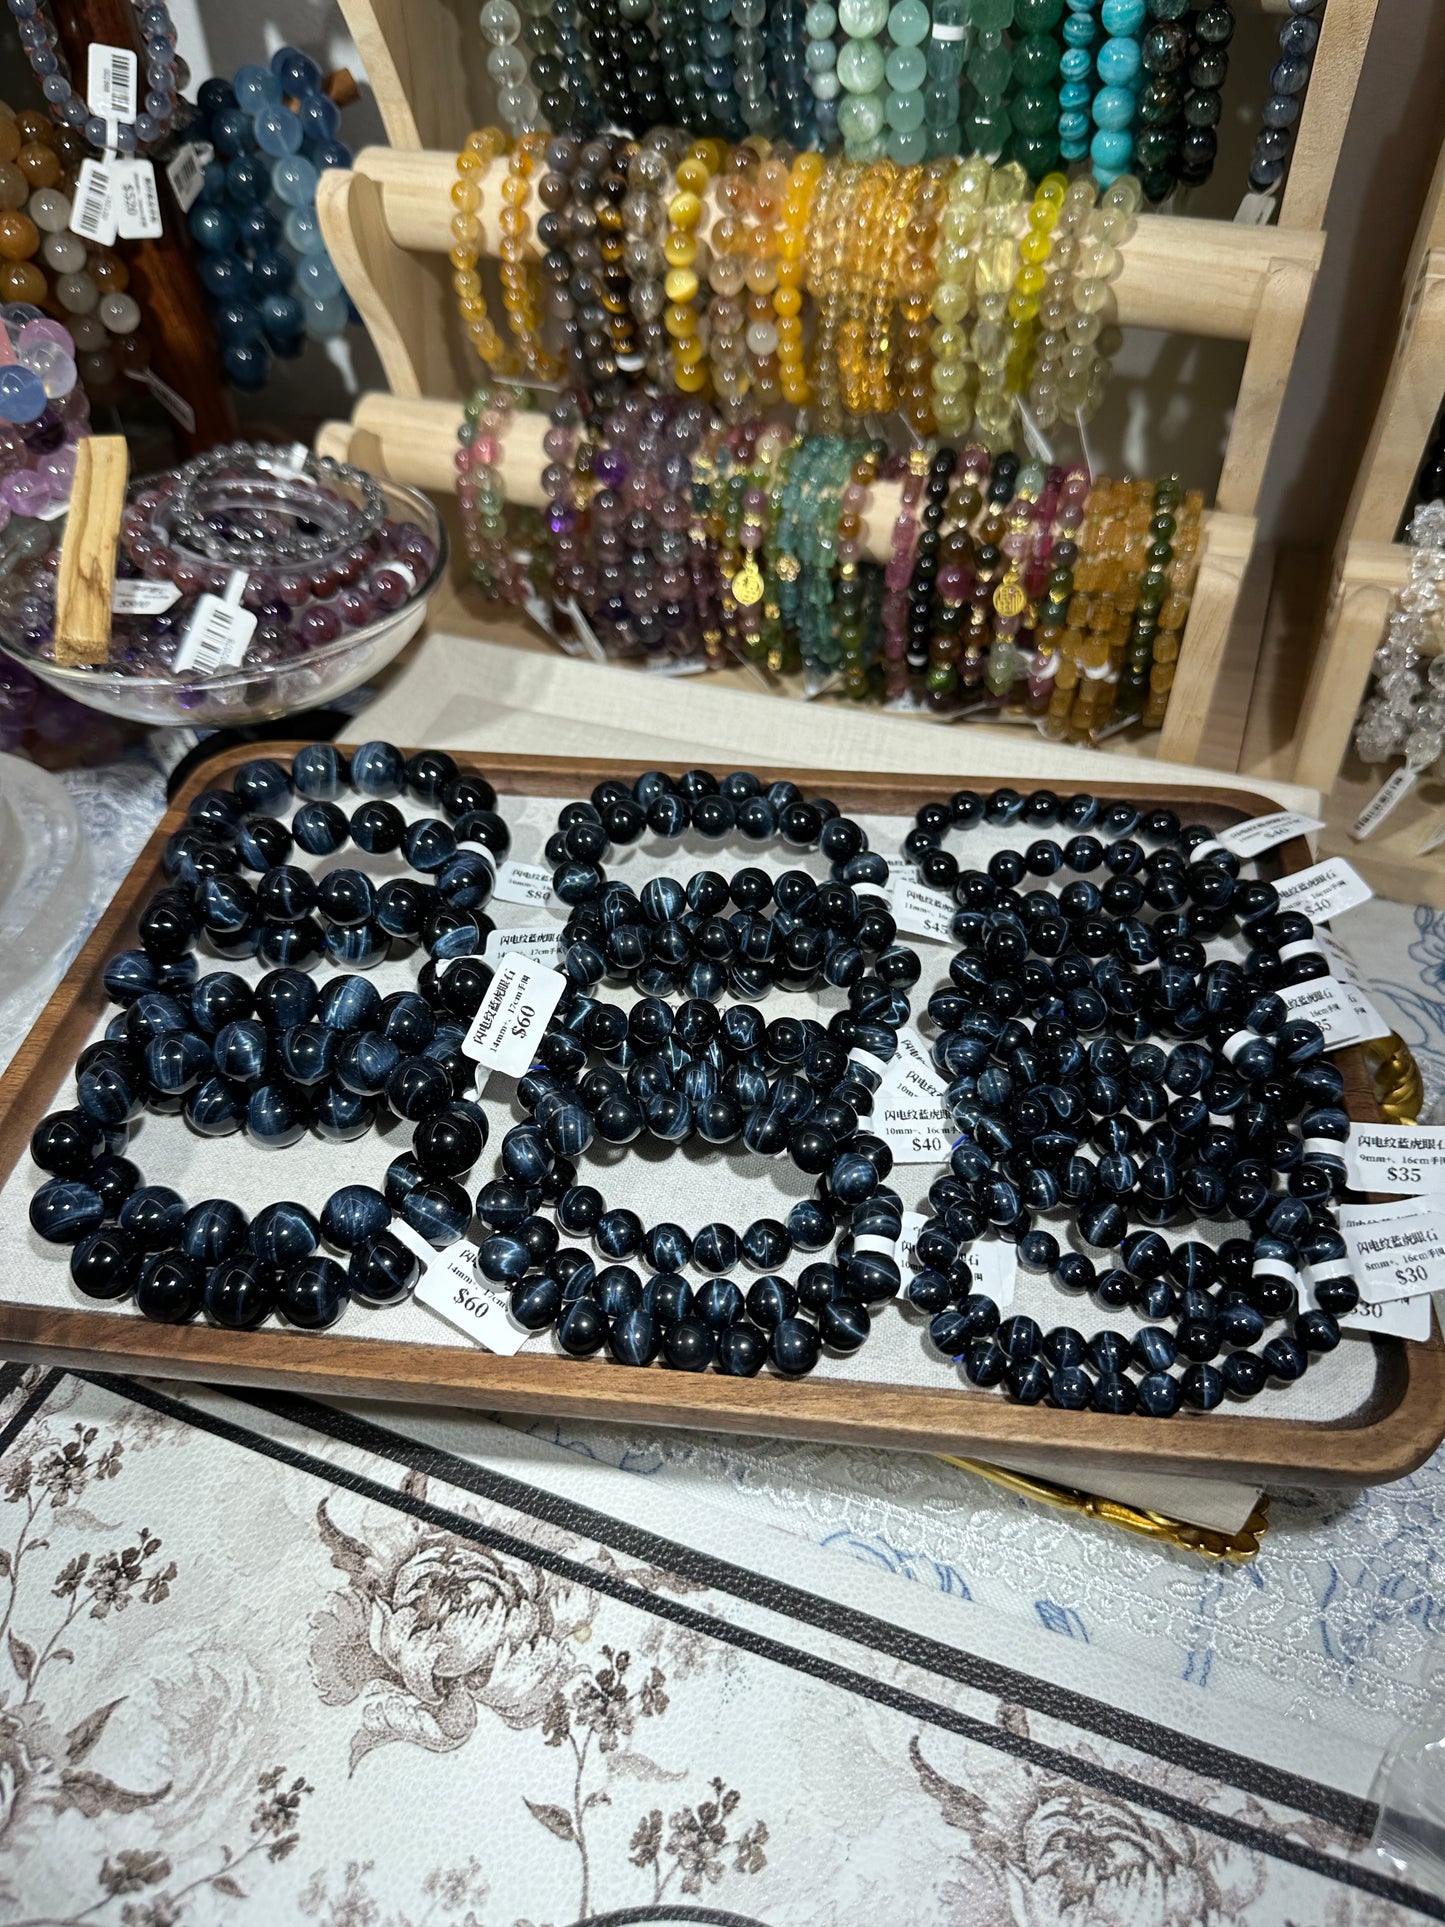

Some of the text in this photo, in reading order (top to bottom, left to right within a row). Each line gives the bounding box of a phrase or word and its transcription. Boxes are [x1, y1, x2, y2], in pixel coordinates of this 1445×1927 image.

[1304, 899, 1331, 917] $40
[473, 968, 516, 1045] 闪电纹蓝虎眼石
[511, 1005, 536, 1039] $60
[896, 1082, 919, 1098] 10m
[912, 1137, 942, 1151] $40
[1387, 1166, 1422, 1182] $35
[1356, 1228, 1439, 1255] 闪电纹蓝虎眼石
[1395, 1264, 1429, 1286] $30
[453, 1287, 490, 1319] $60
